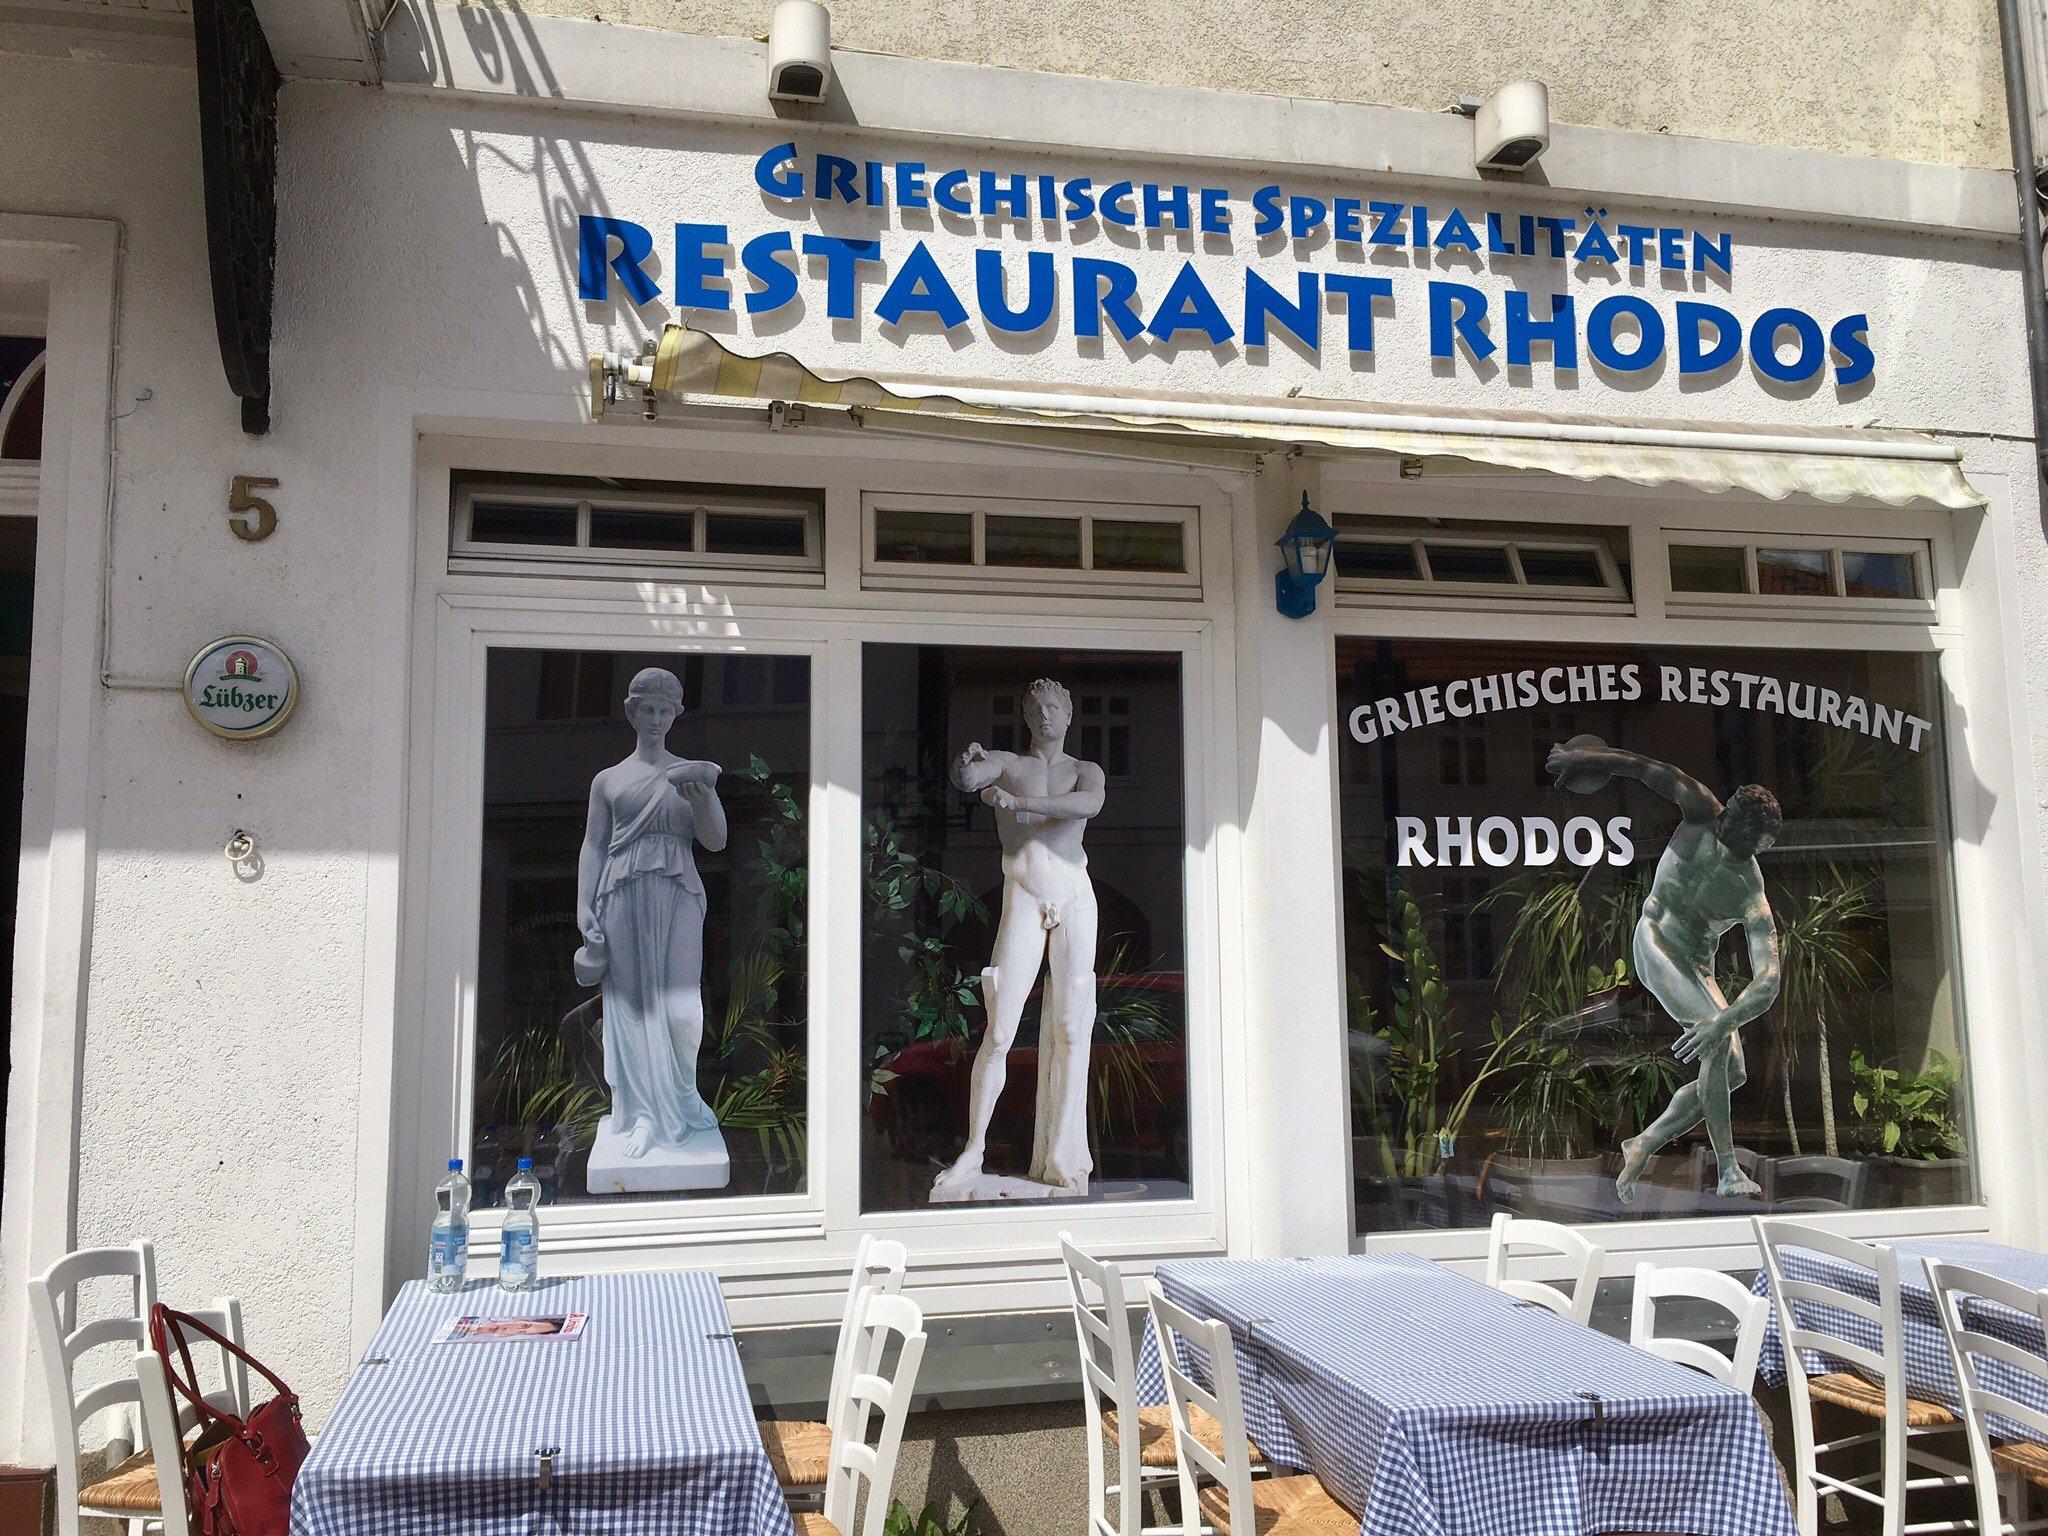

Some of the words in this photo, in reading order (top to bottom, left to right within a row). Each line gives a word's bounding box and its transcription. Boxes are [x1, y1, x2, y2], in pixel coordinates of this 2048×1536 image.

[755, 143, 1230, 234] GRIECHISCHE
[1253, 186, 1732, 275] SPEZIALITÄTEN
[578, 215, 1393, 352] RESTAURANT
[1428, 282, 1875, 385] RHODOS
[228, 476, 280, 543] 5
[198, 683, 279, 713] Lübzer
[1348, 664, 1642, 744] GRIECHISCHES
[1660, 665, 1933, 753] RESTAURANT
[1395, 816, 1635, 867] RHODOS
